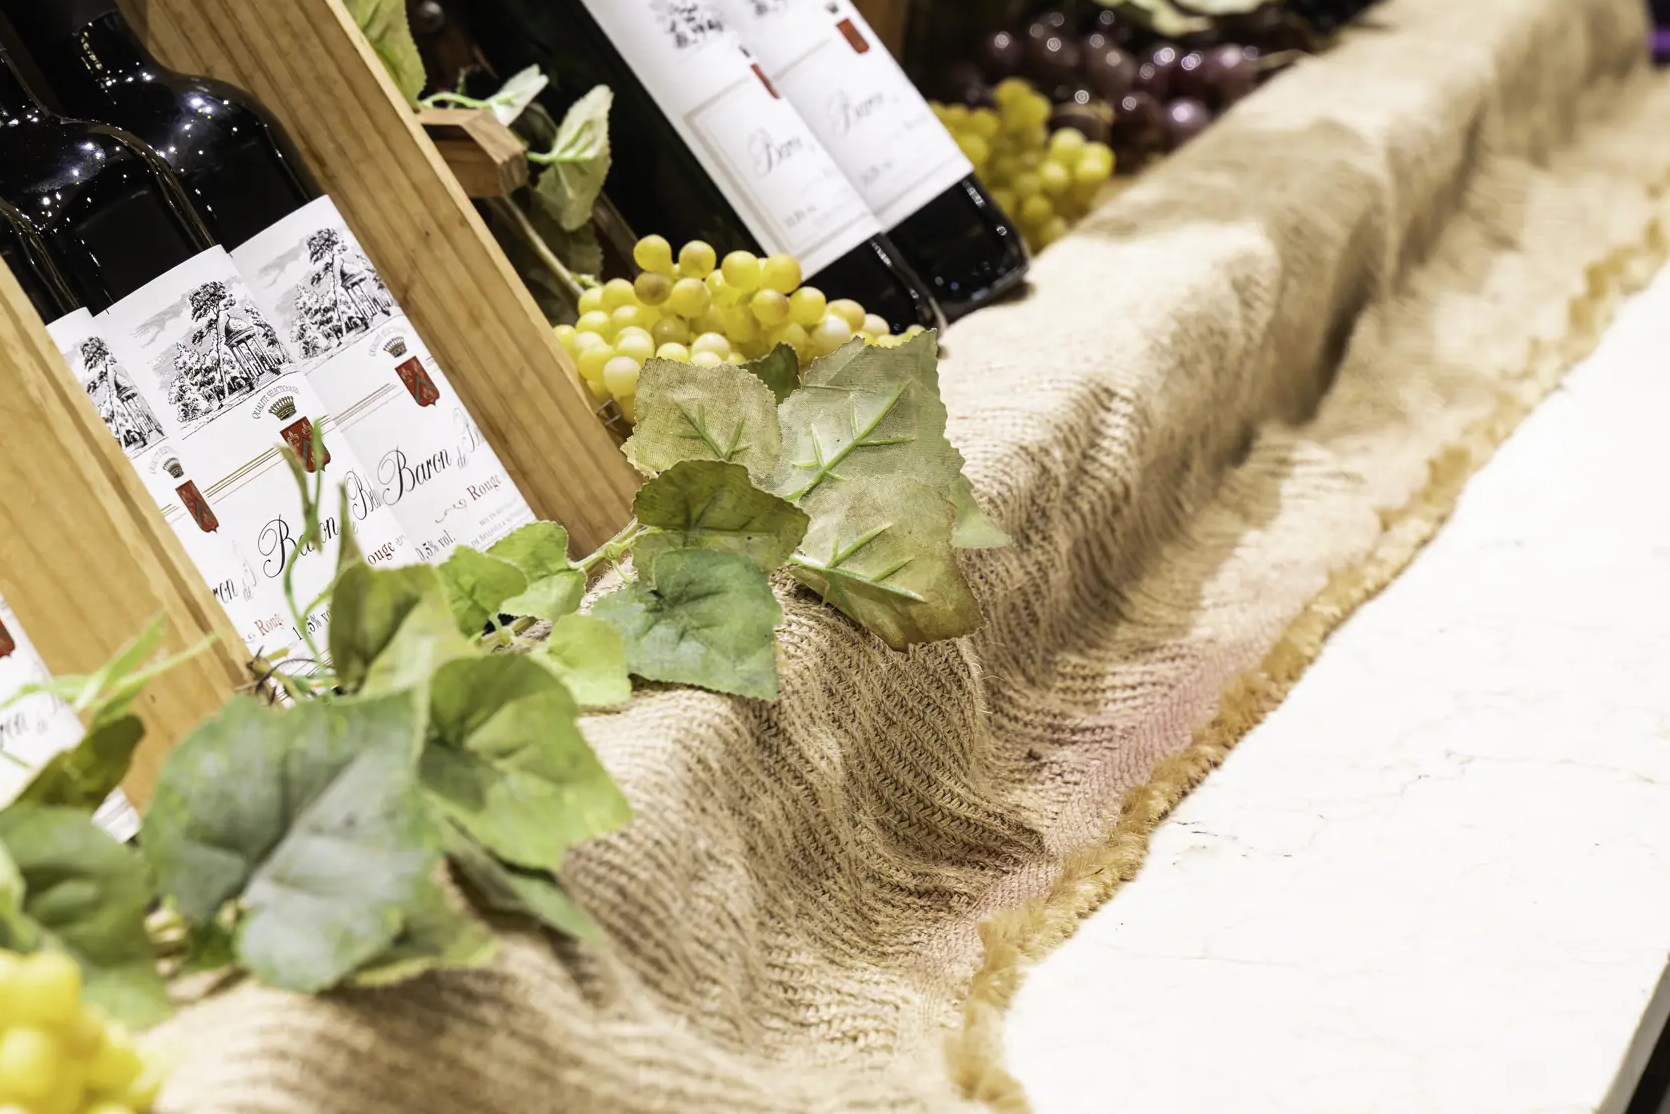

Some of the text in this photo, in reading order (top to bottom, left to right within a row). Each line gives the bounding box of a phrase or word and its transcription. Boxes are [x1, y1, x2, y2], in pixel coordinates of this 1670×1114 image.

[377, 446, 452, 505] Baron
[466, 474, 502, 501] Rouge
[258, 514, 338, 578] Baon
[438, 529, 457, 549] vol.
[367, 541, 396, 565] ouge
[292, 613, 323, 641] 1,5%
